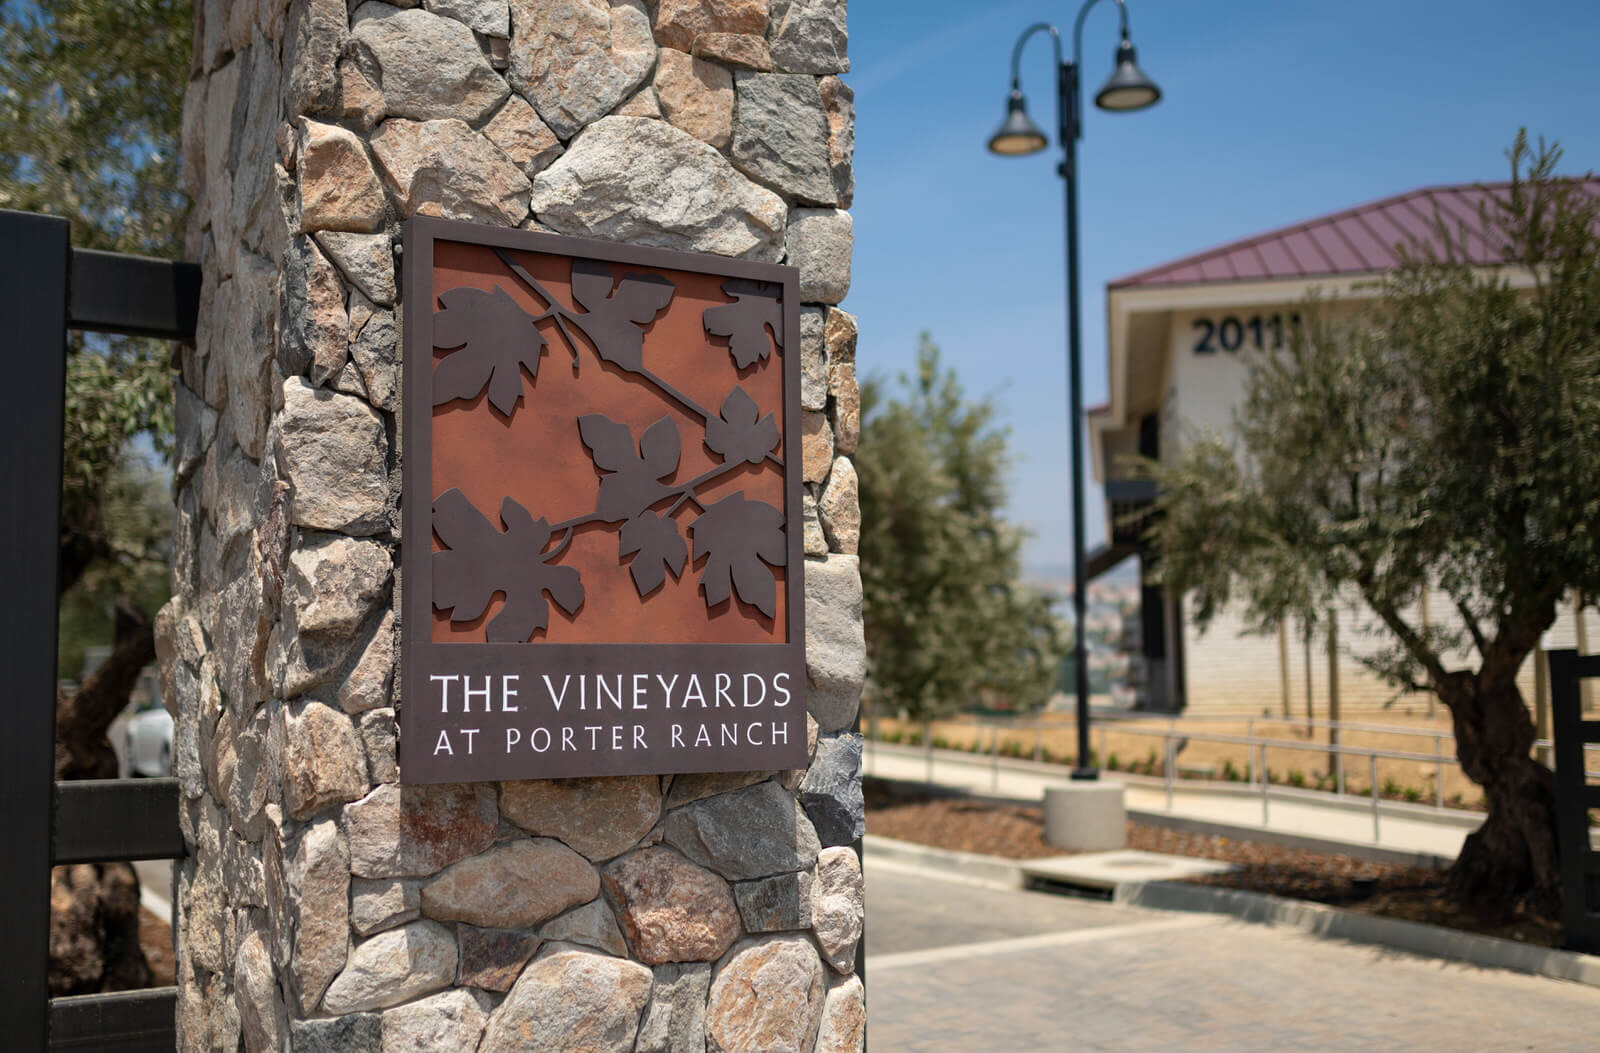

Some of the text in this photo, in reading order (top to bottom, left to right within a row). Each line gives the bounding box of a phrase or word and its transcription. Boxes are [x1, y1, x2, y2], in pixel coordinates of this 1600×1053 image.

[1192, 313, 1302, 354] 2011
[430, 672, 791, 713] THE VINEYARDS
[433, 722, 789, 756] AT PORTER RANCH
